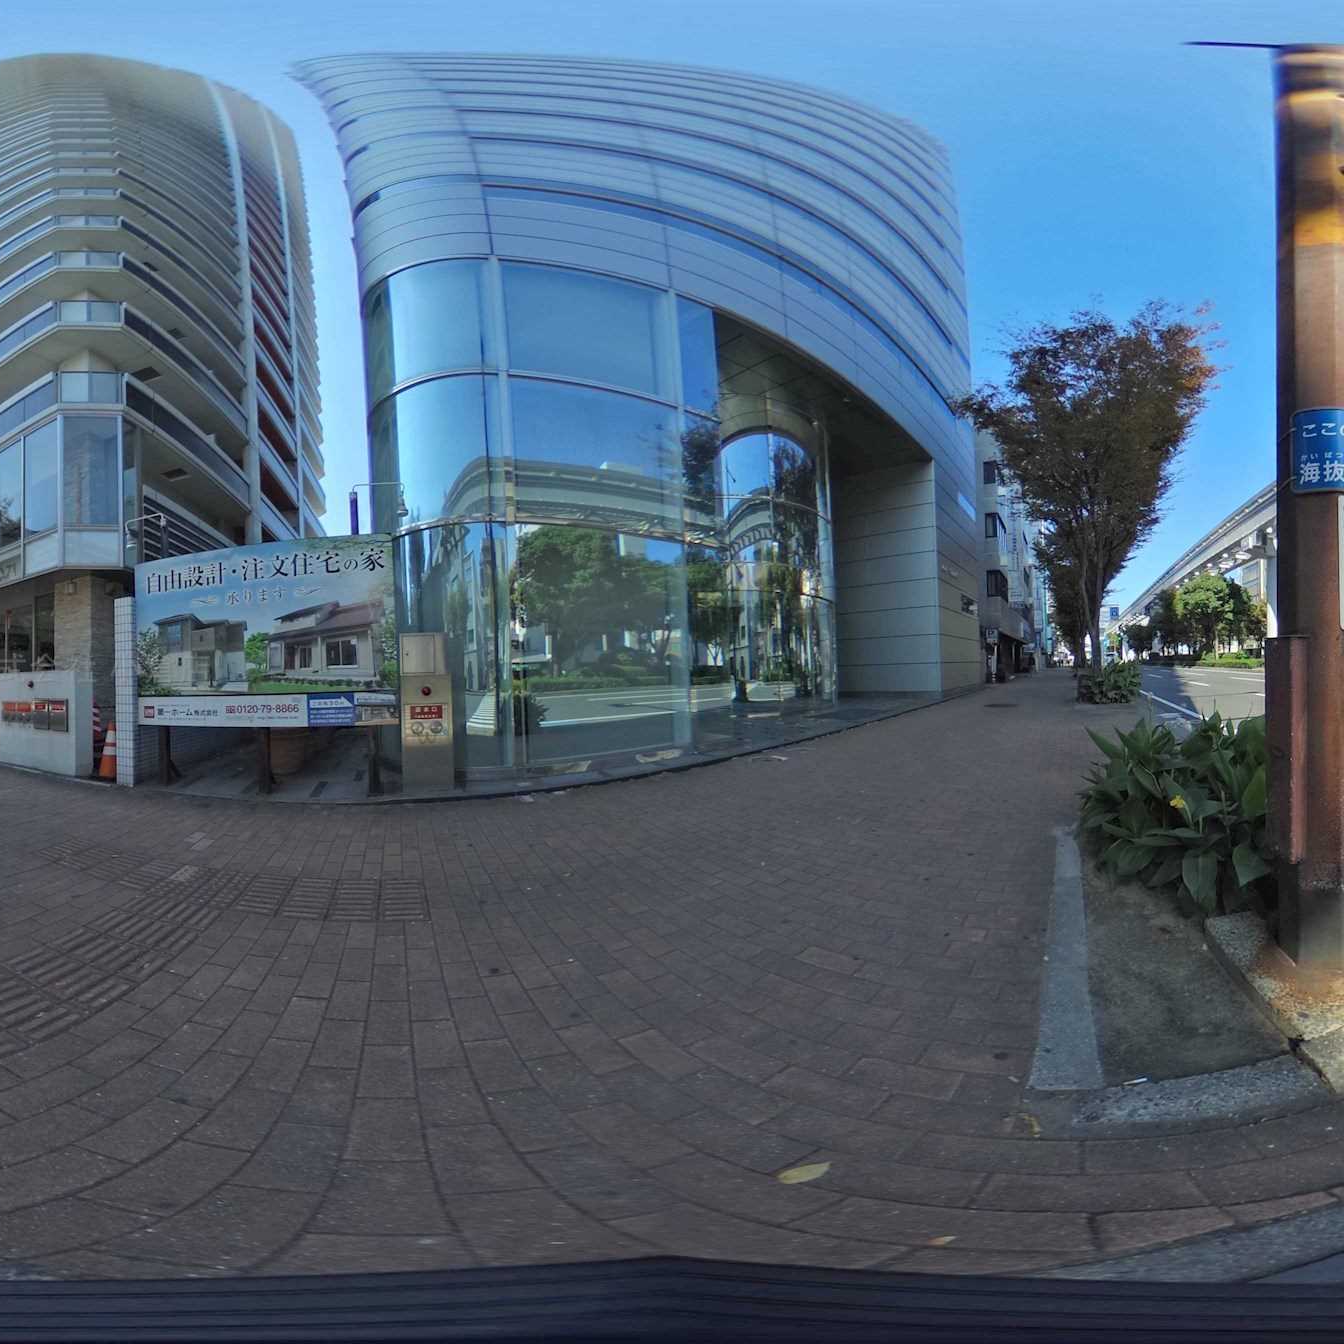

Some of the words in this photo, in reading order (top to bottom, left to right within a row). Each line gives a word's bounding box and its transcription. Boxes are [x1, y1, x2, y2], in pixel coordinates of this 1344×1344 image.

[1302, 423, 1344, 437] ここ
[1299, 460, 1344, 485] 海抜
[146, 548, 385, 595] 自由設計・注文住宅の家
[225, 586, 287, 605] 承ります
[236, 704, 300, 714] 0120-79-8866
